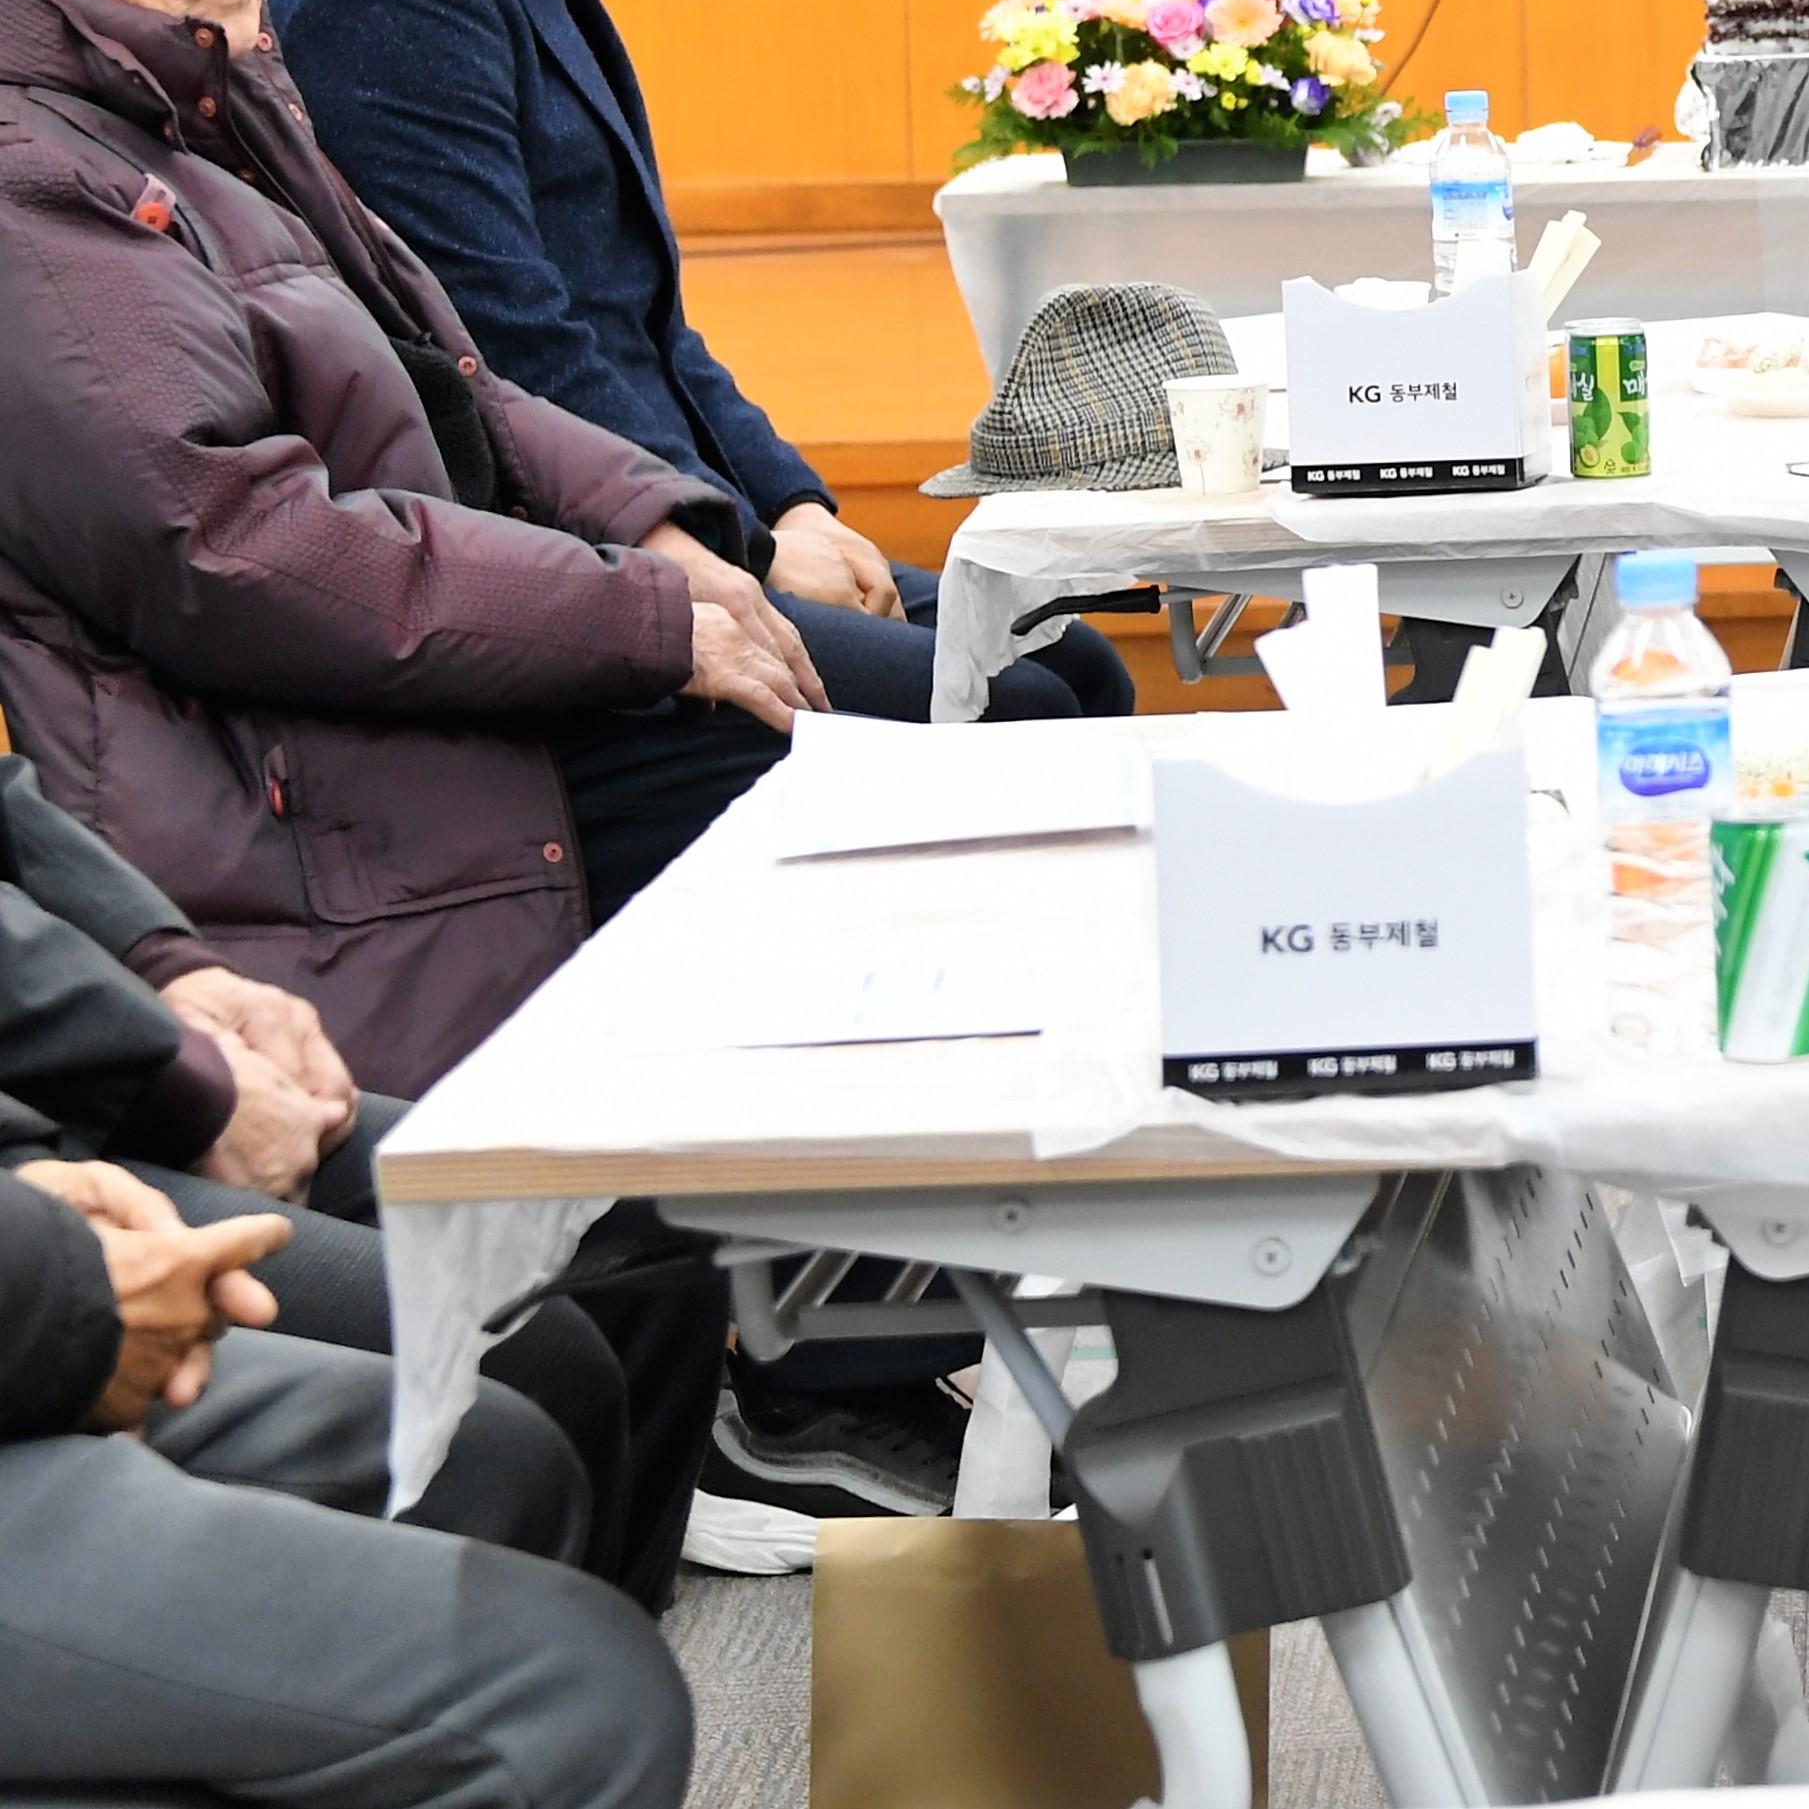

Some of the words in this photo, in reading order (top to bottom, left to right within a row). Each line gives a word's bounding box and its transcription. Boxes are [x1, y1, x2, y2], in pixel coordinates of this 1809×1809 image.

[1348, 384, 1382, 404] KG
[1389, 381, 1457, 403] 동부제철
[1622, 370, 1649, 397] 매
[1307, 471, 1325, 482] KG
[1380, 468, 1397, 479] KG
[1452, 465, 1470, 476] KG
[1261, 924, 1315, 954] KG
[1329, 920, 1439, 952] 동부제철
[1307, 1057, 1338, 1078] KG
[1426, 1051, 1457, 1072] KG
[1188, 1062, 1220, 1083] KG
